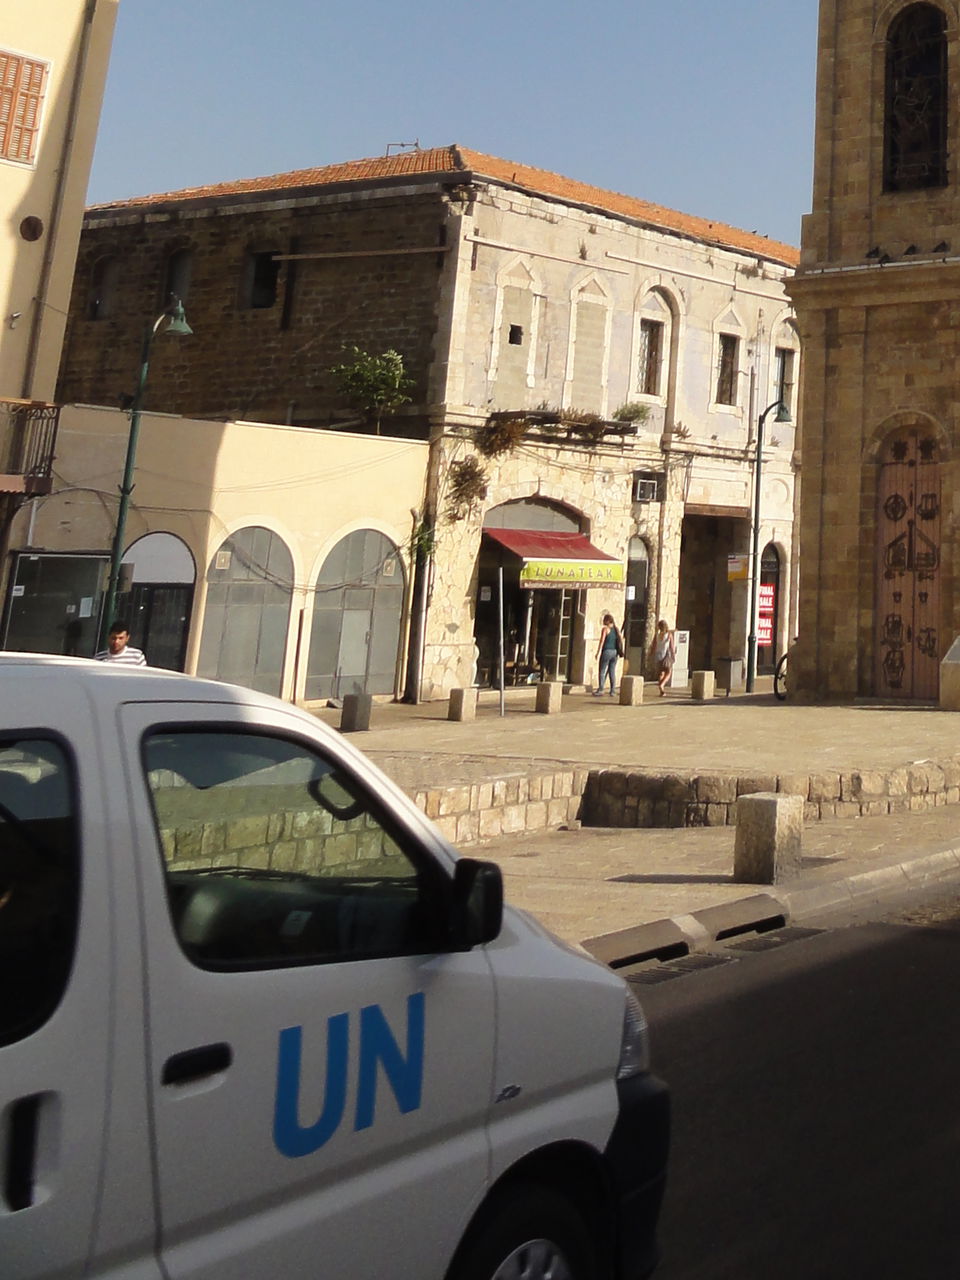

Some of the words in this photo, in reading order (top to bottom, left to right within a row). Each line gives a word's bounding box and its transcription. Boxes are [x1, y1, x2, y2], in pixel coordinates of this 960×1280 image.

[535, 567, 613, 579] LUNATEAK
[760, 586, 774, 595] FINAL
[760, 597, 773, 606] SALE
[758, 629, 771, 638] SALE
[272, 991, 426, 1159] UN
